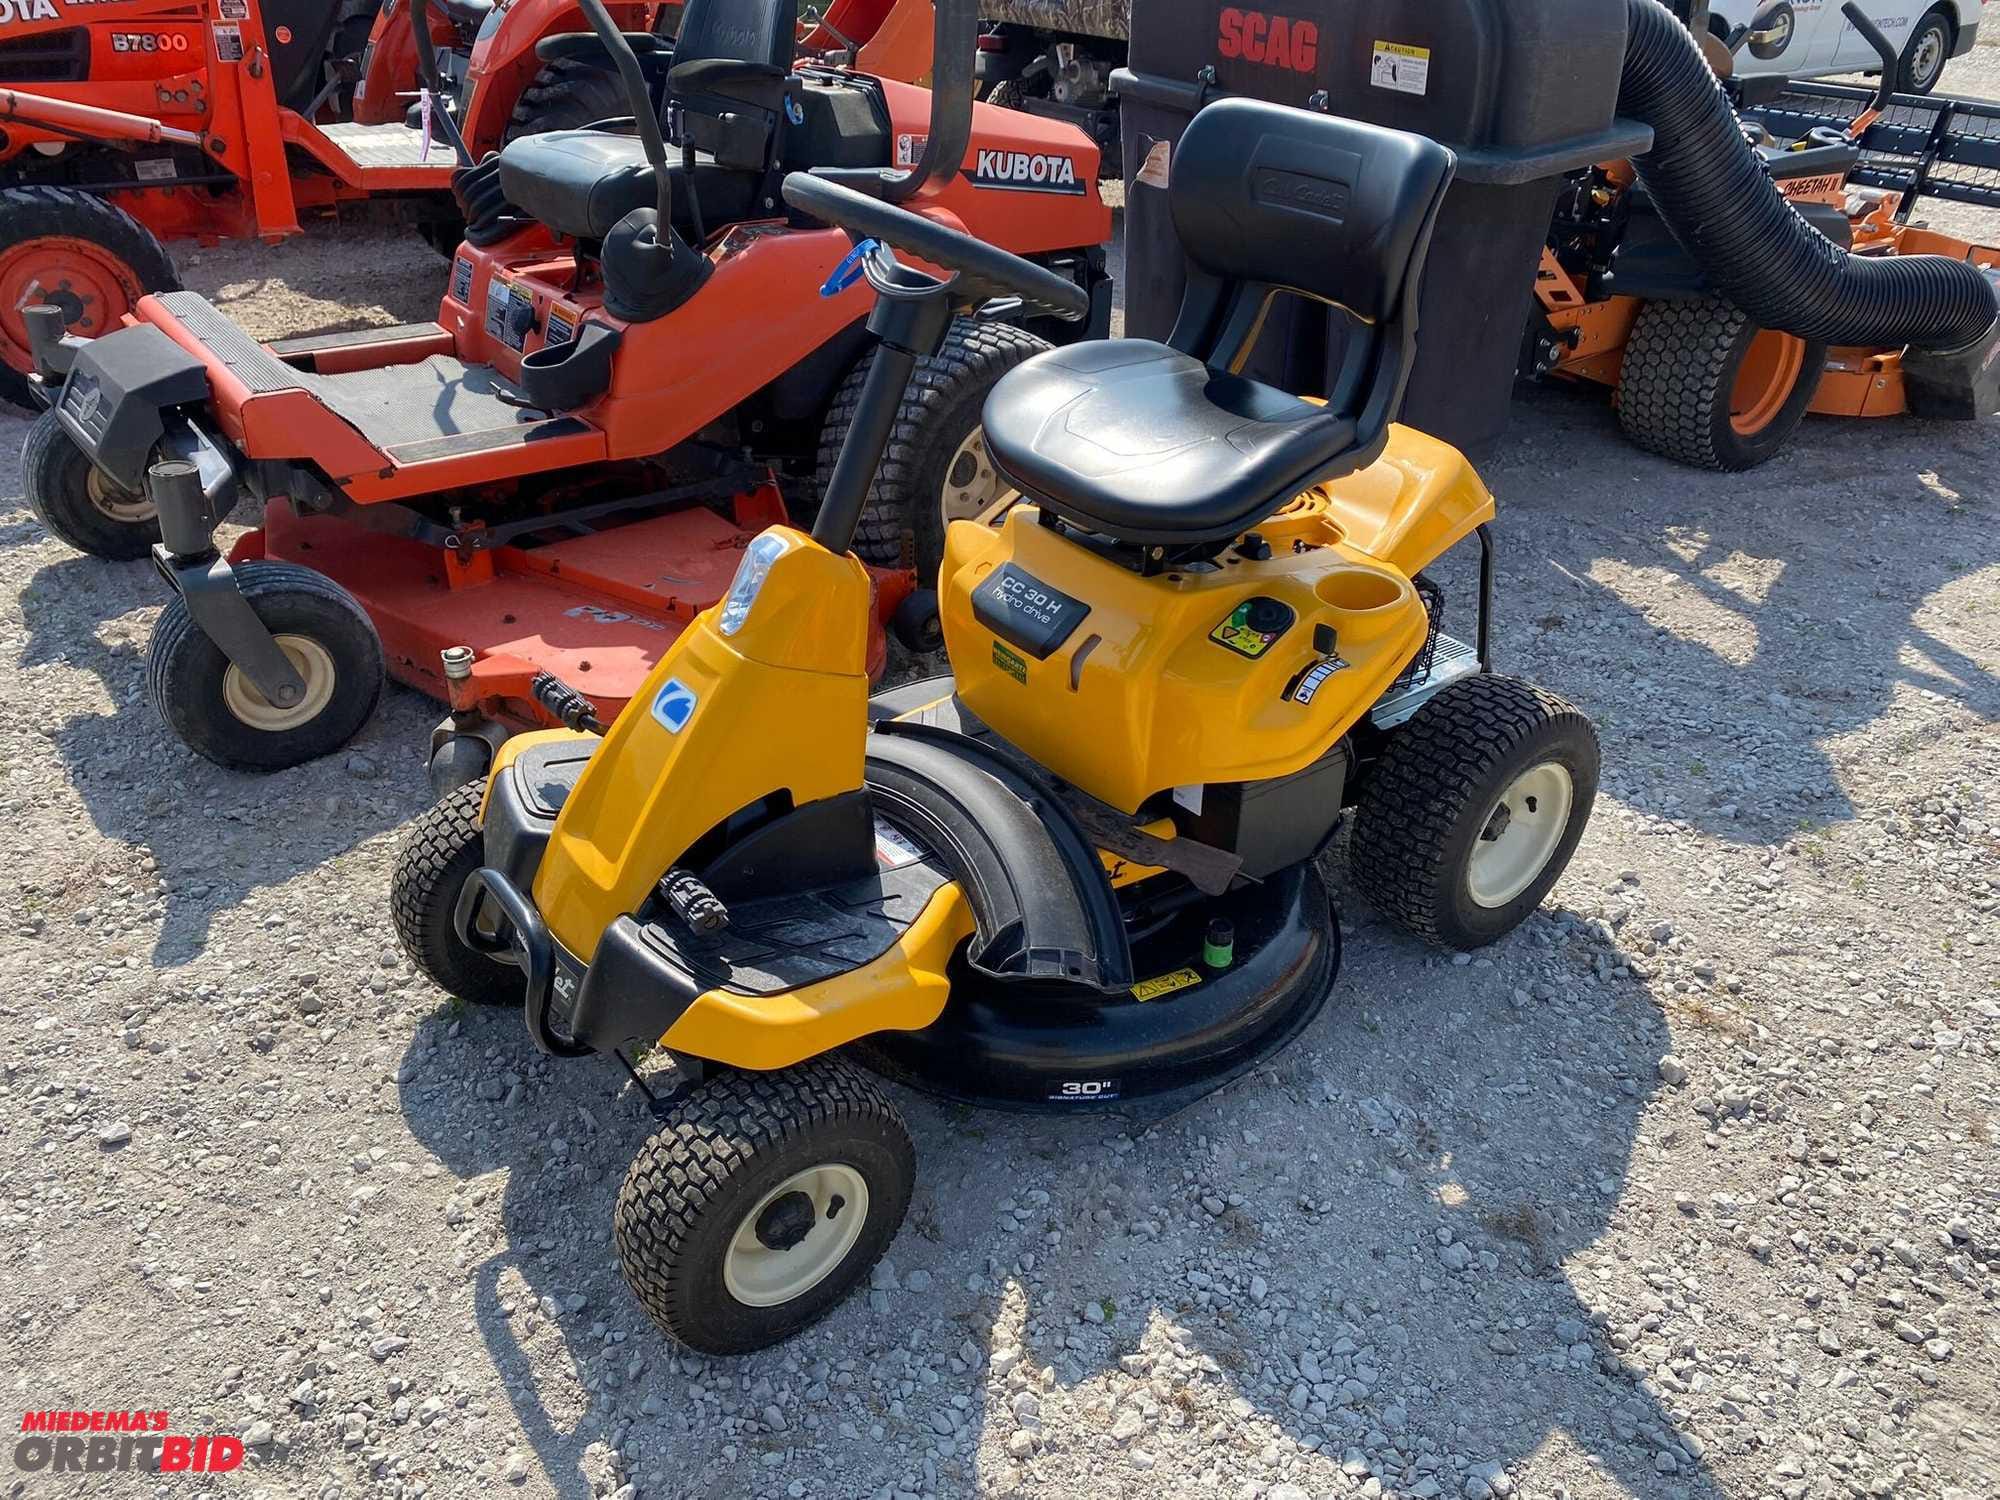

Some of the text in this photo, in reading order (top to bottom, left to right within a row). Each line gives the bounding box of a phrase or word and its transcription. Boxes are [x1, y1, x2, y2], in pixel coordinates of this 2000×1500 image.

[112, 33, 188, 51] B7800
[1218, 7, 1318, 73] SCAG
[976, 149, 1075, 185] KUBOTA
[1784, 178, 1830, 196] CHEETAH
[992, 586, 1052, 624] hydro drive
[1001, 576, 1062, 614] CC 30 H
[1062, 1081, 1111, 1095] 30"
